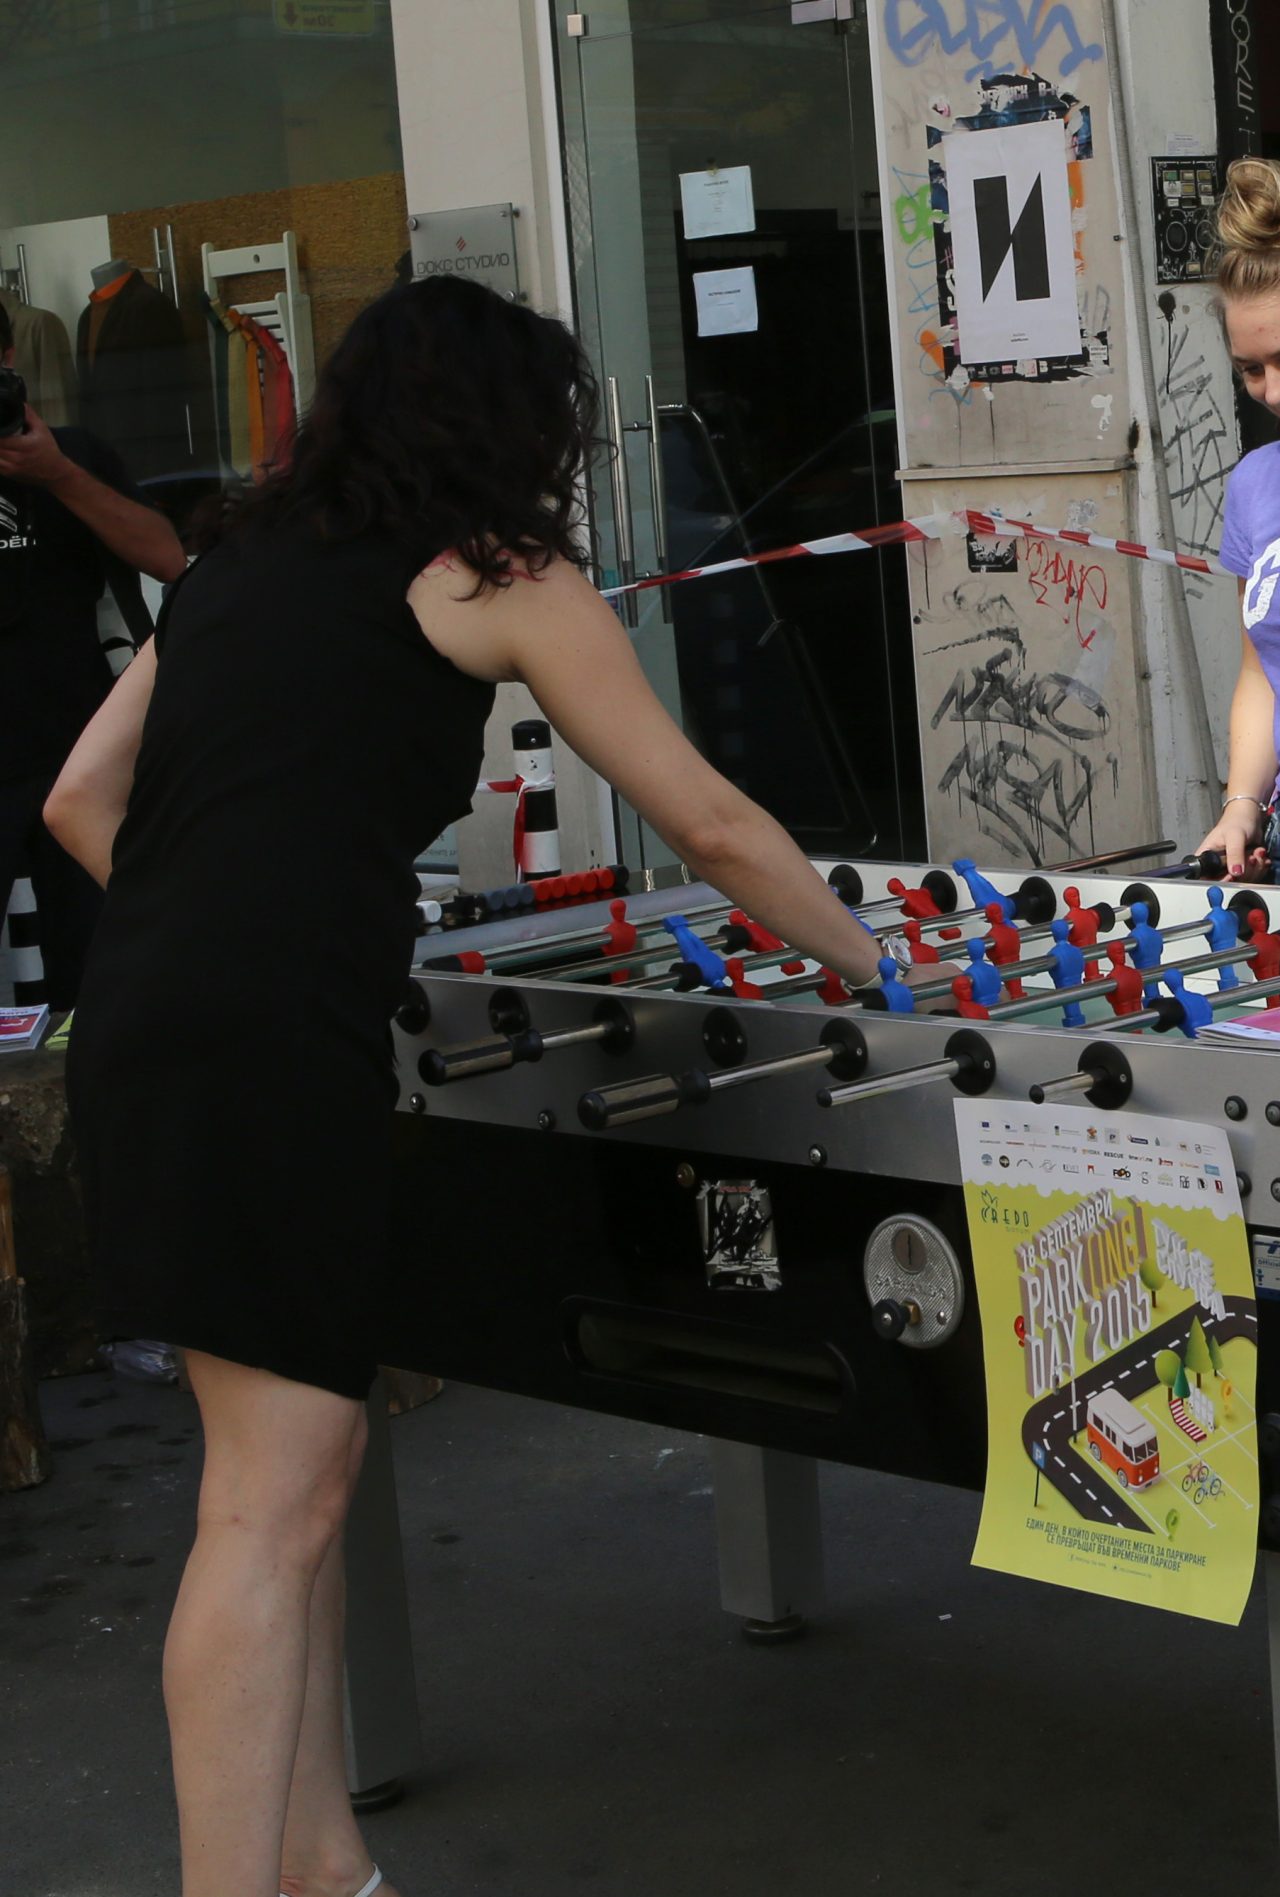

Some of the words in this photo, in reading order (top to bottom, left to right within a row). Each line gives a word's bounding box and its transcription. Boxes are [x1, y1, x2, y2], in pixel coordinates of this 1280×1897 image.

[1018, 1243, 1036, 1273] 18
[1036, 1189, 1113, 1260] СЕПТЕМВРИ
[1257, 1259, 1280, 1267] Official
[1027, 1313, 1076, 1398] DAY
[1026, 1518, 1045, 1532] ЕДИН
[1062, 1525, 1067, 1535] В
[1067, 1526, 1090, 1540] КОЙТО
[1091, 1531, 1132, 1548] ОЧЕРТАНИТЕ
[1133, 1540, 1155, 1555] МЕСТА
[1156, 1545, 1165, 1557] ЗА
[1166, 1547, 1207, 1567] ПАРКИРАНЕ
[1046, 1534, 1056, 1545] СЕ
[1056, 1535, 1096, 1554] ПРЕВРЪЩАТ
[1097, 1544, 1111, 1557] ВЪВ
[1112, 1547, 1150, 1565] ВРЕМЕННИ
[1151, 1555, 1182, 1572] ПАРКОВЕ
